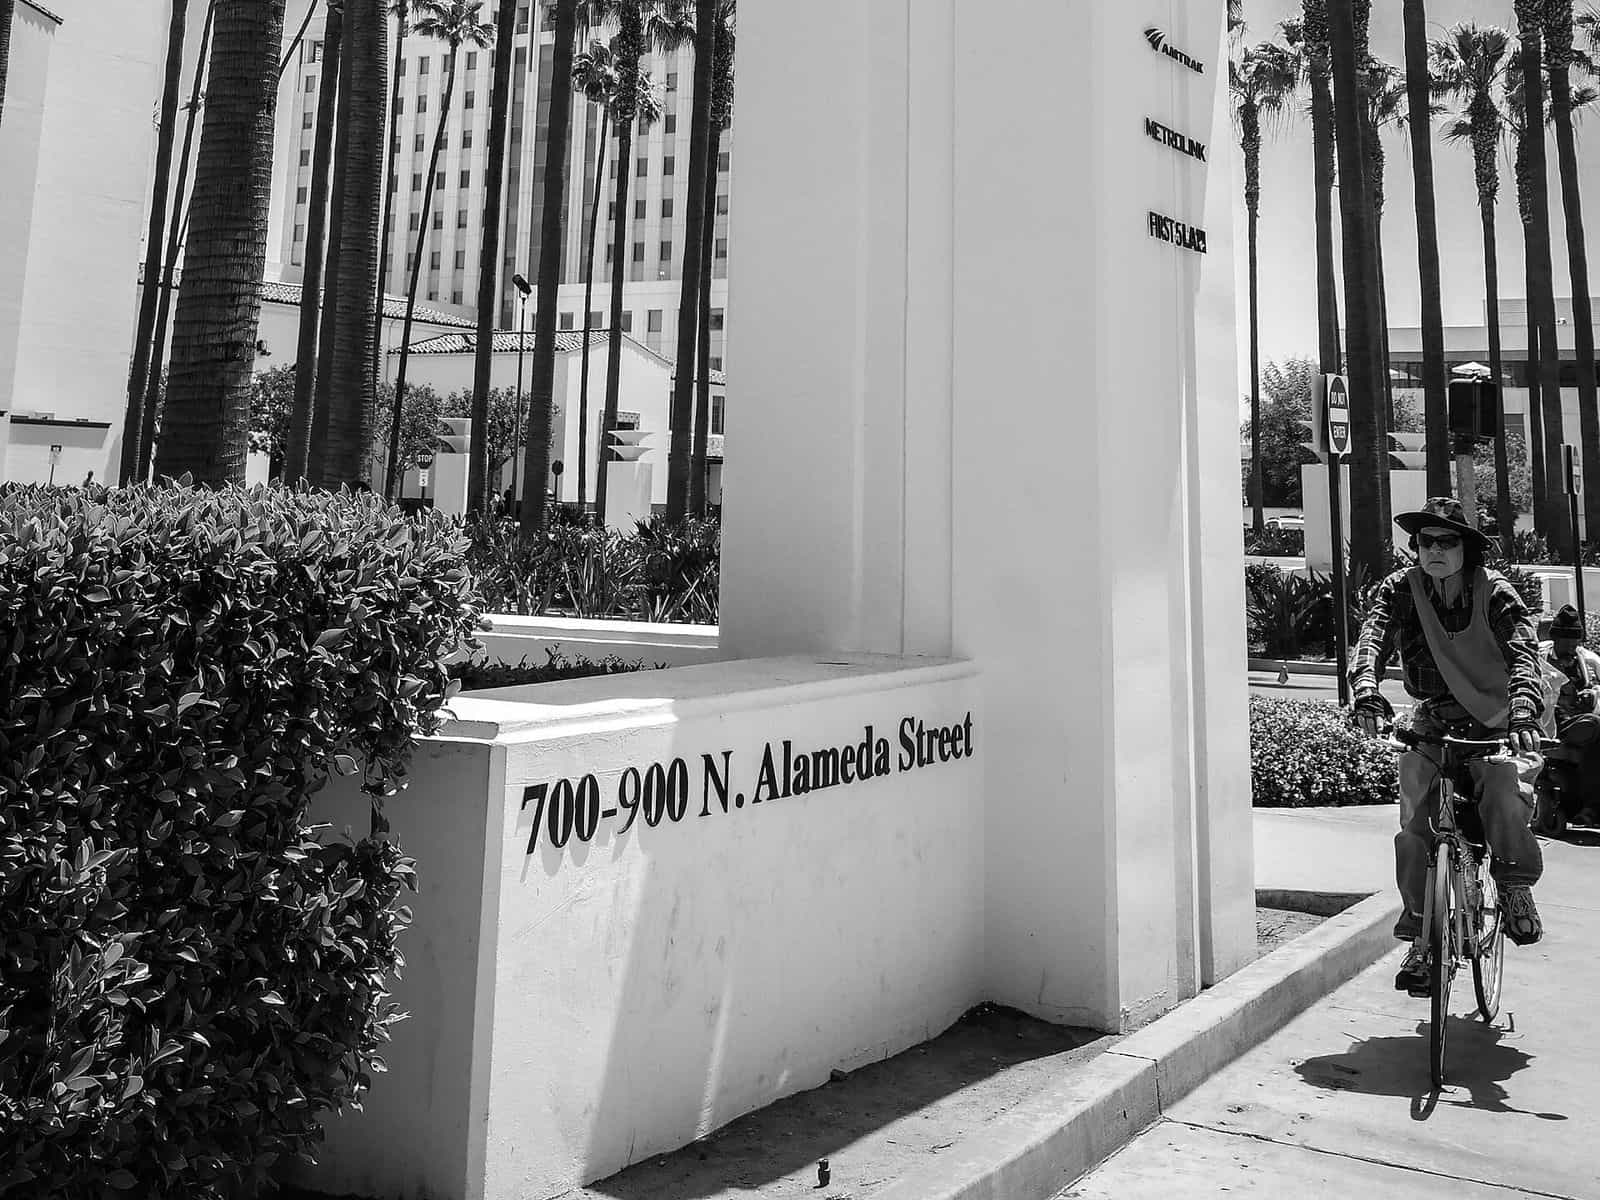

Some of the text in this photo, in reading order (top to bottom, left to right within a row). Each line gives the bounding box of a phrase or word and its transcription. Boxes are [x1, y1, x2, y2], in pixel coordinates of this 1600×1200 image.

[1161, 44, 1204, 73] AMTRAK
[1146, 117, 1206, 162] METROLINK
[521, 711, 974, 855] 700-900 N. Alameda Street
